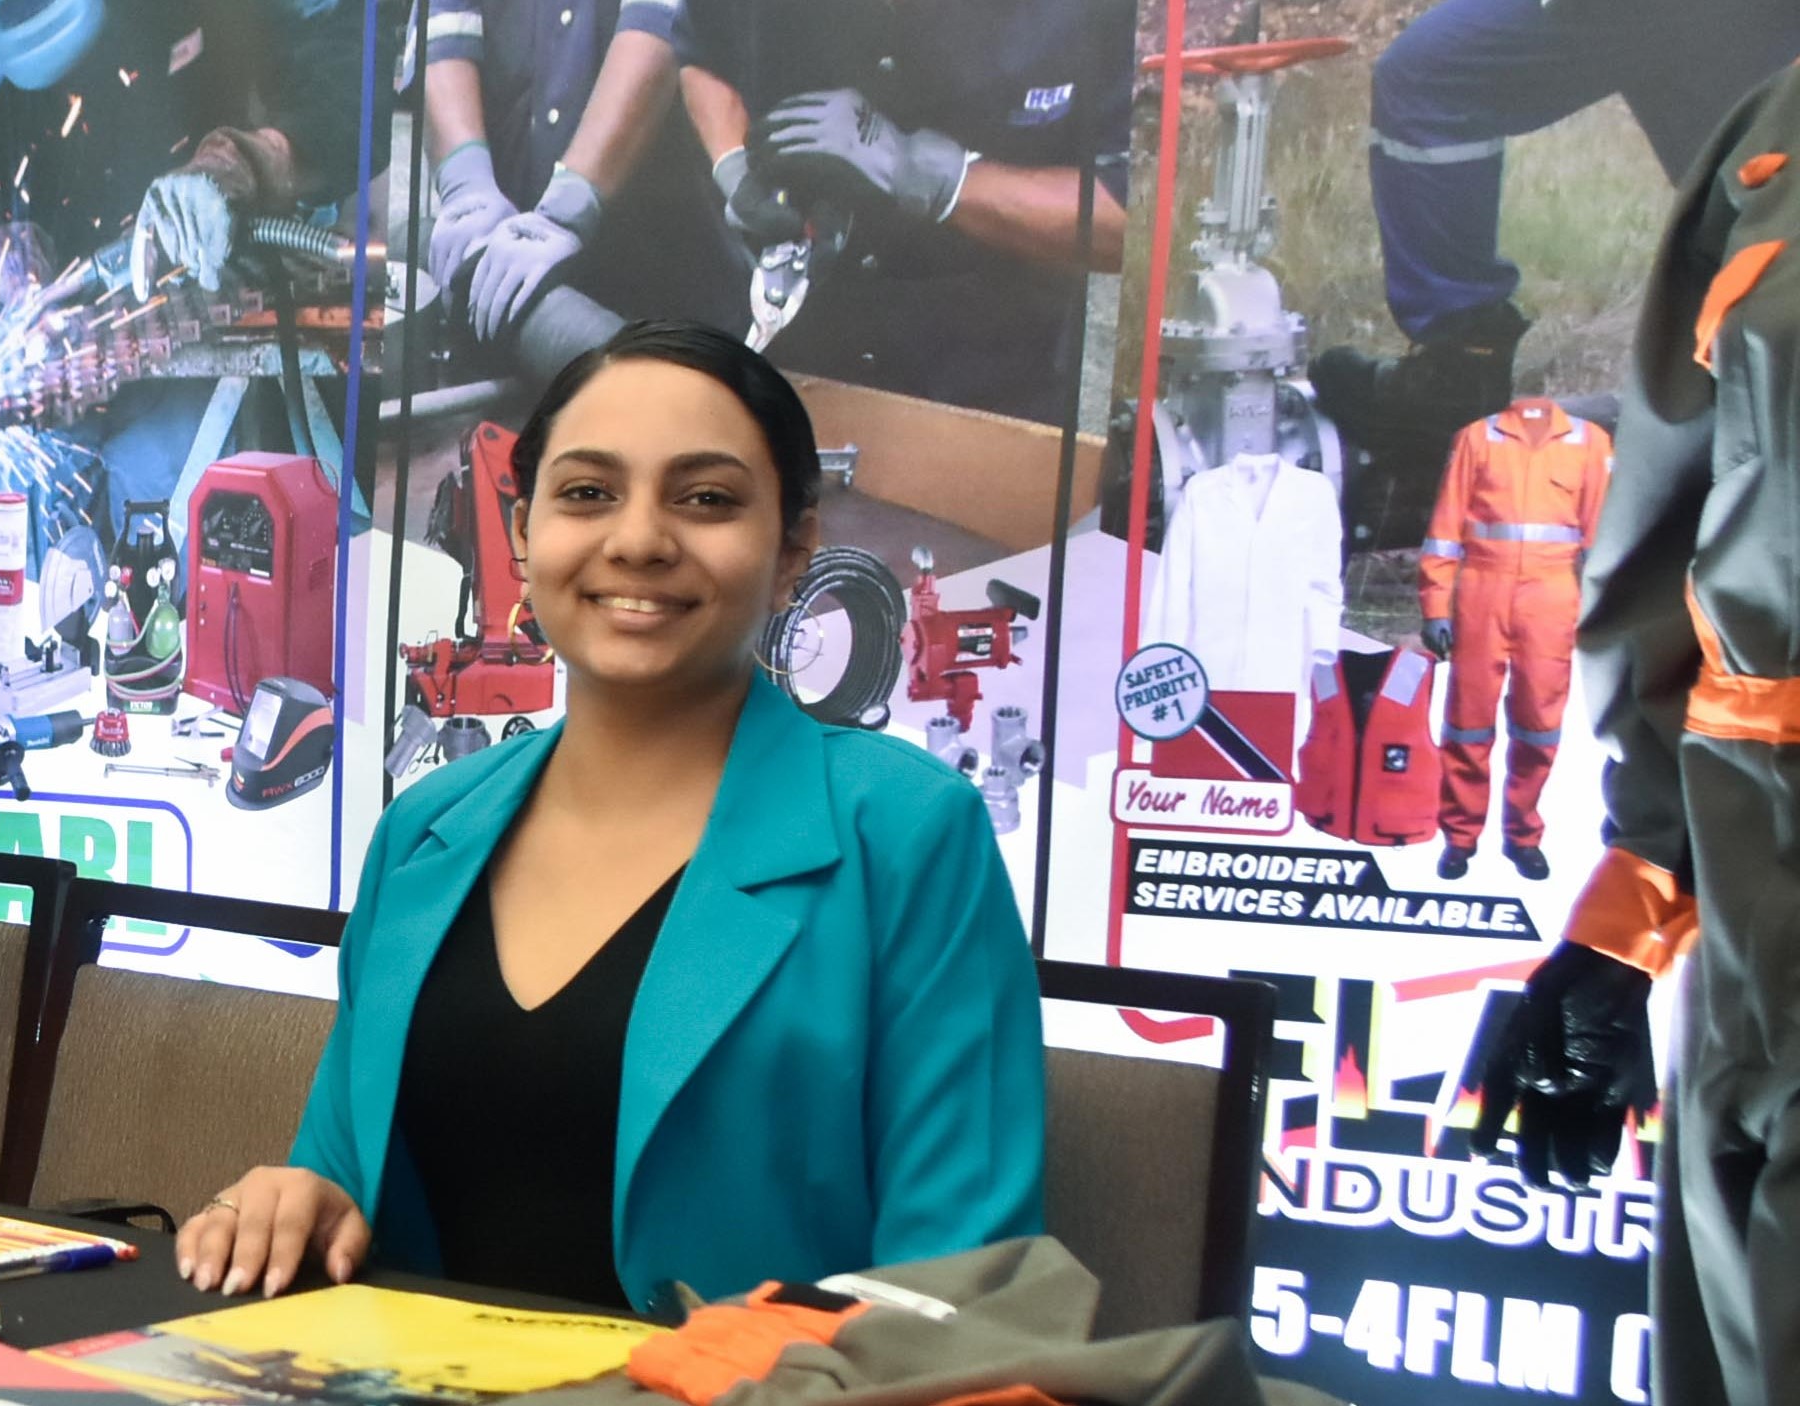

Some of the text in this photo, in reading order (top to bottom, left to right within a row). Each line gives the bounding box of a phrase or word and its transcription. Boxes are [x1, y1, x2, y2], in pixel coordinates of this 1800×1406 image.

[1123, 671, 1199, 712] PRIORITY
[1125, 655, 1185, 689] SAFETY
[1151, 698, 1185, 723] #1
[1125, 779, 1280, 820] Your Name
[1134, 848, 1368, 887] EMBROIDERY
[1133, 882, 1528, 933] SERVICES AVAILABLE.
